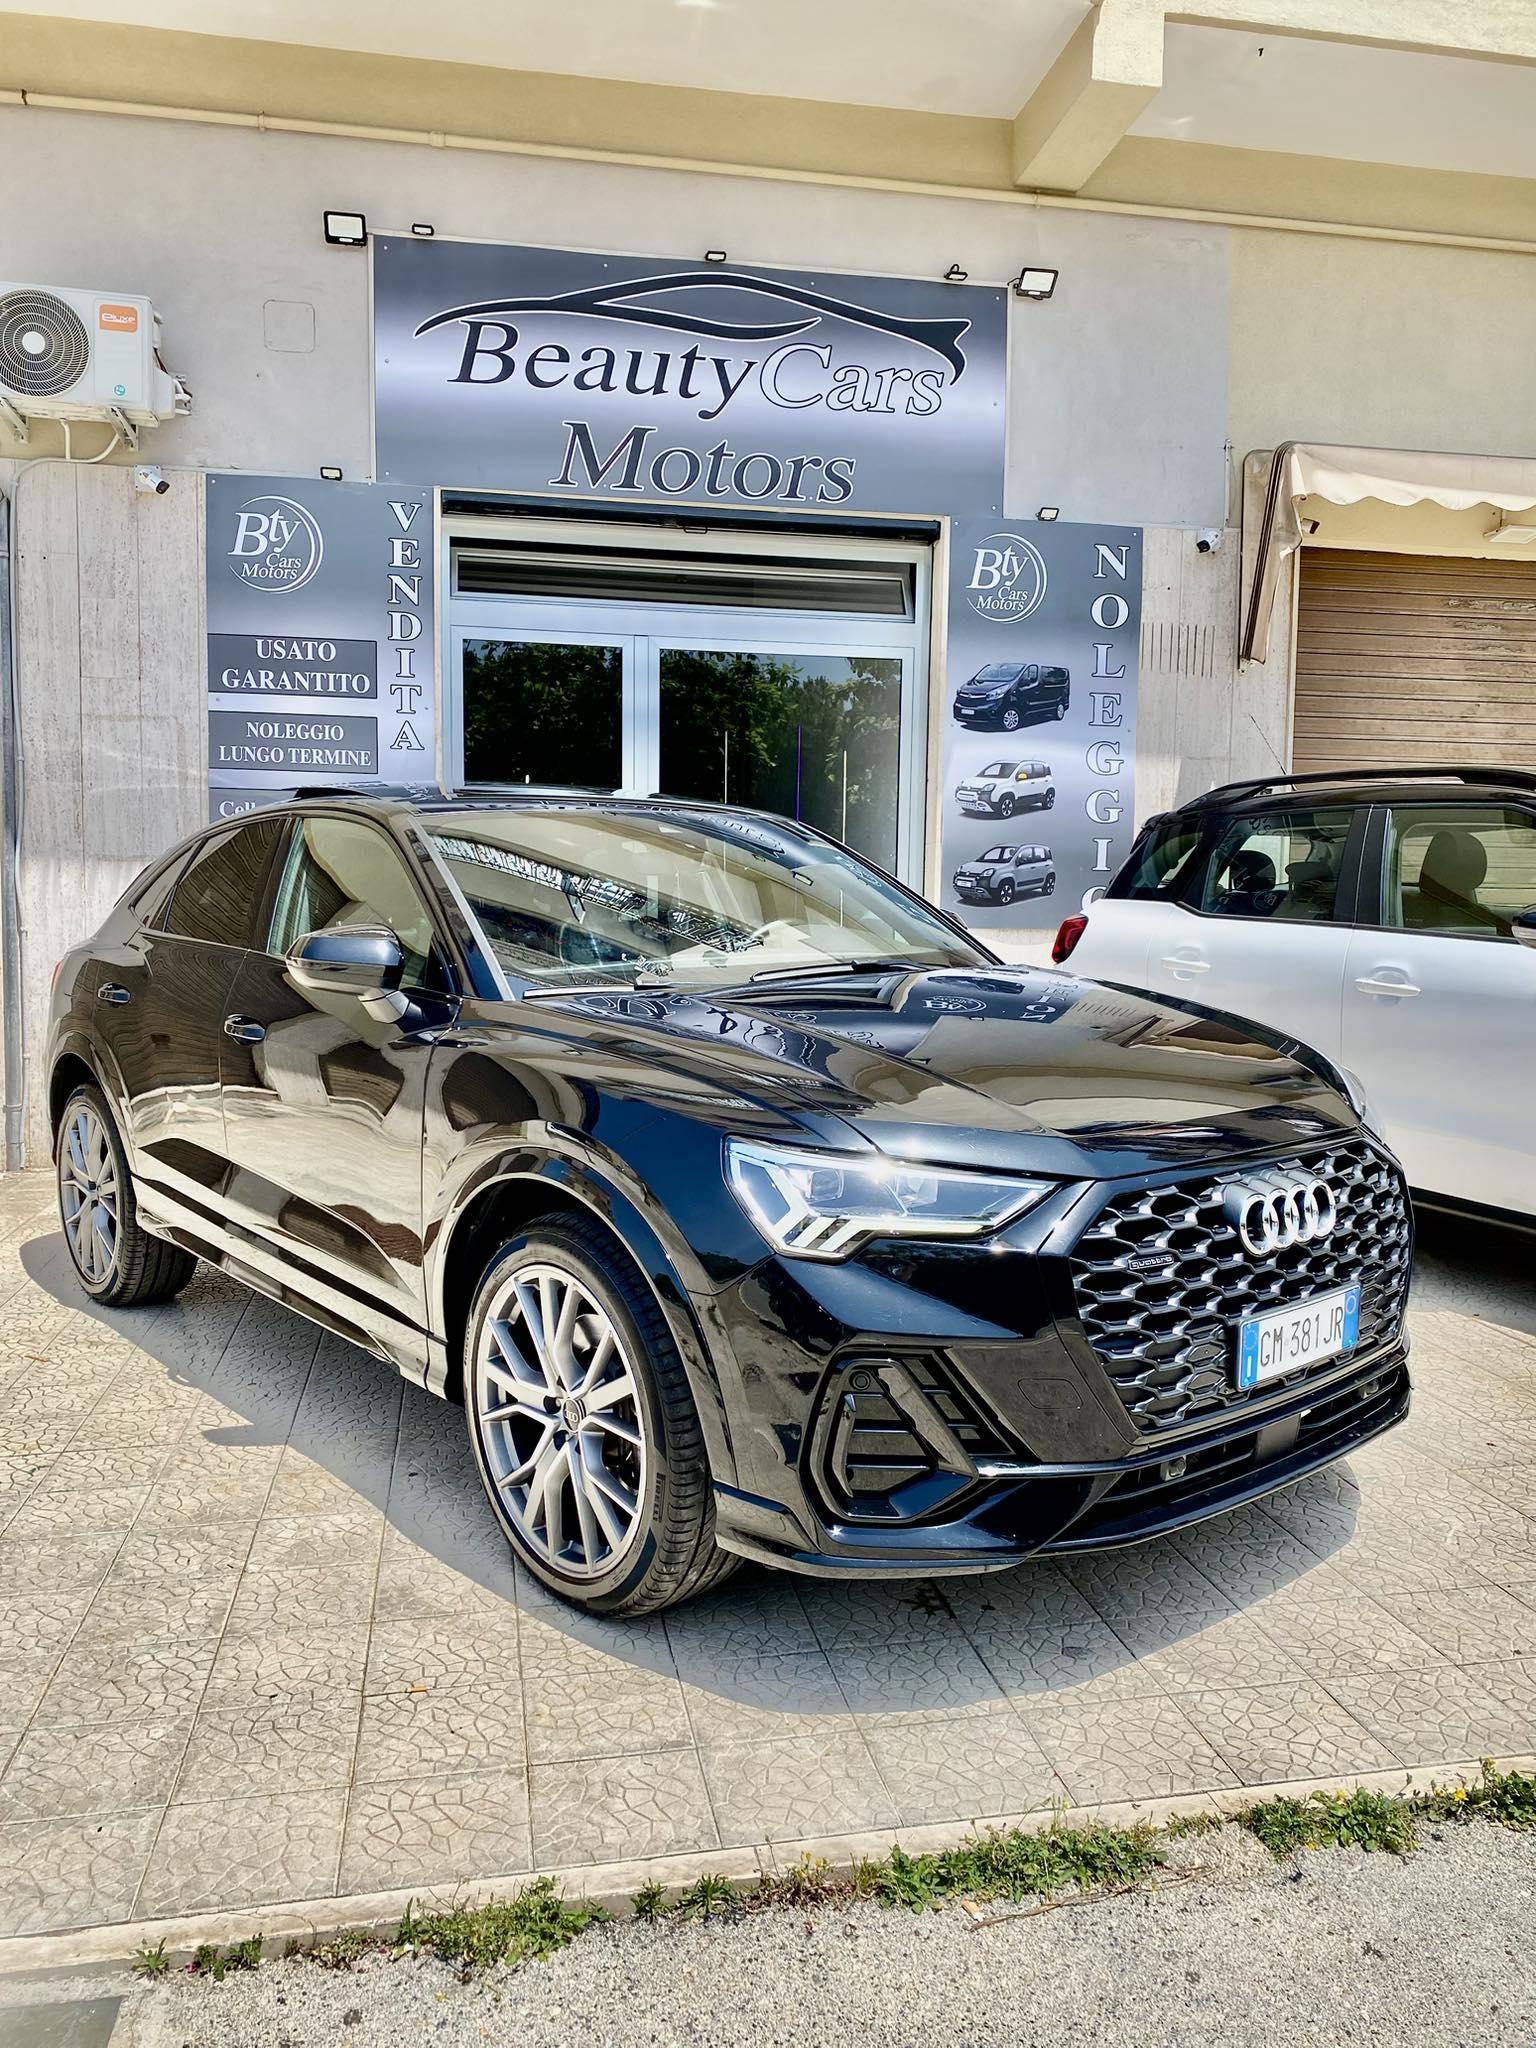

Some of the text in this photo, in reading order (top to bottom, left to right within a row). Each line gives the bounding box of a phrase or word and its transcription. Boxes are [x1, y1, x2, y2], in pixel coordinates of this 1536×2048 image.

[548, 420, 856, 503] Motors
[227, 508, 301, 556] Bty
[241, 562, 298, 580] Motors
[266, 552, 302, 569] Cars
[966, 545, 1029, 589] Bty
[976, 595, 1025, 611] Motors
[998, 585, 1028, 600] Cars
[386, 500, 425, 750] VENDITA
[256, 638, 337, 662] USATO
[221, 668, 370, 695] GARANTITO
[246, 721, 345, 741] NOLEGGIO
[218, 745, 372, 767] LUNGO TERMINE
[1260, 1326, 1284, 1367] GM
[1290, 1313, 1321, 1357] 381
[1324, 1306, 1344, 1344] JR
